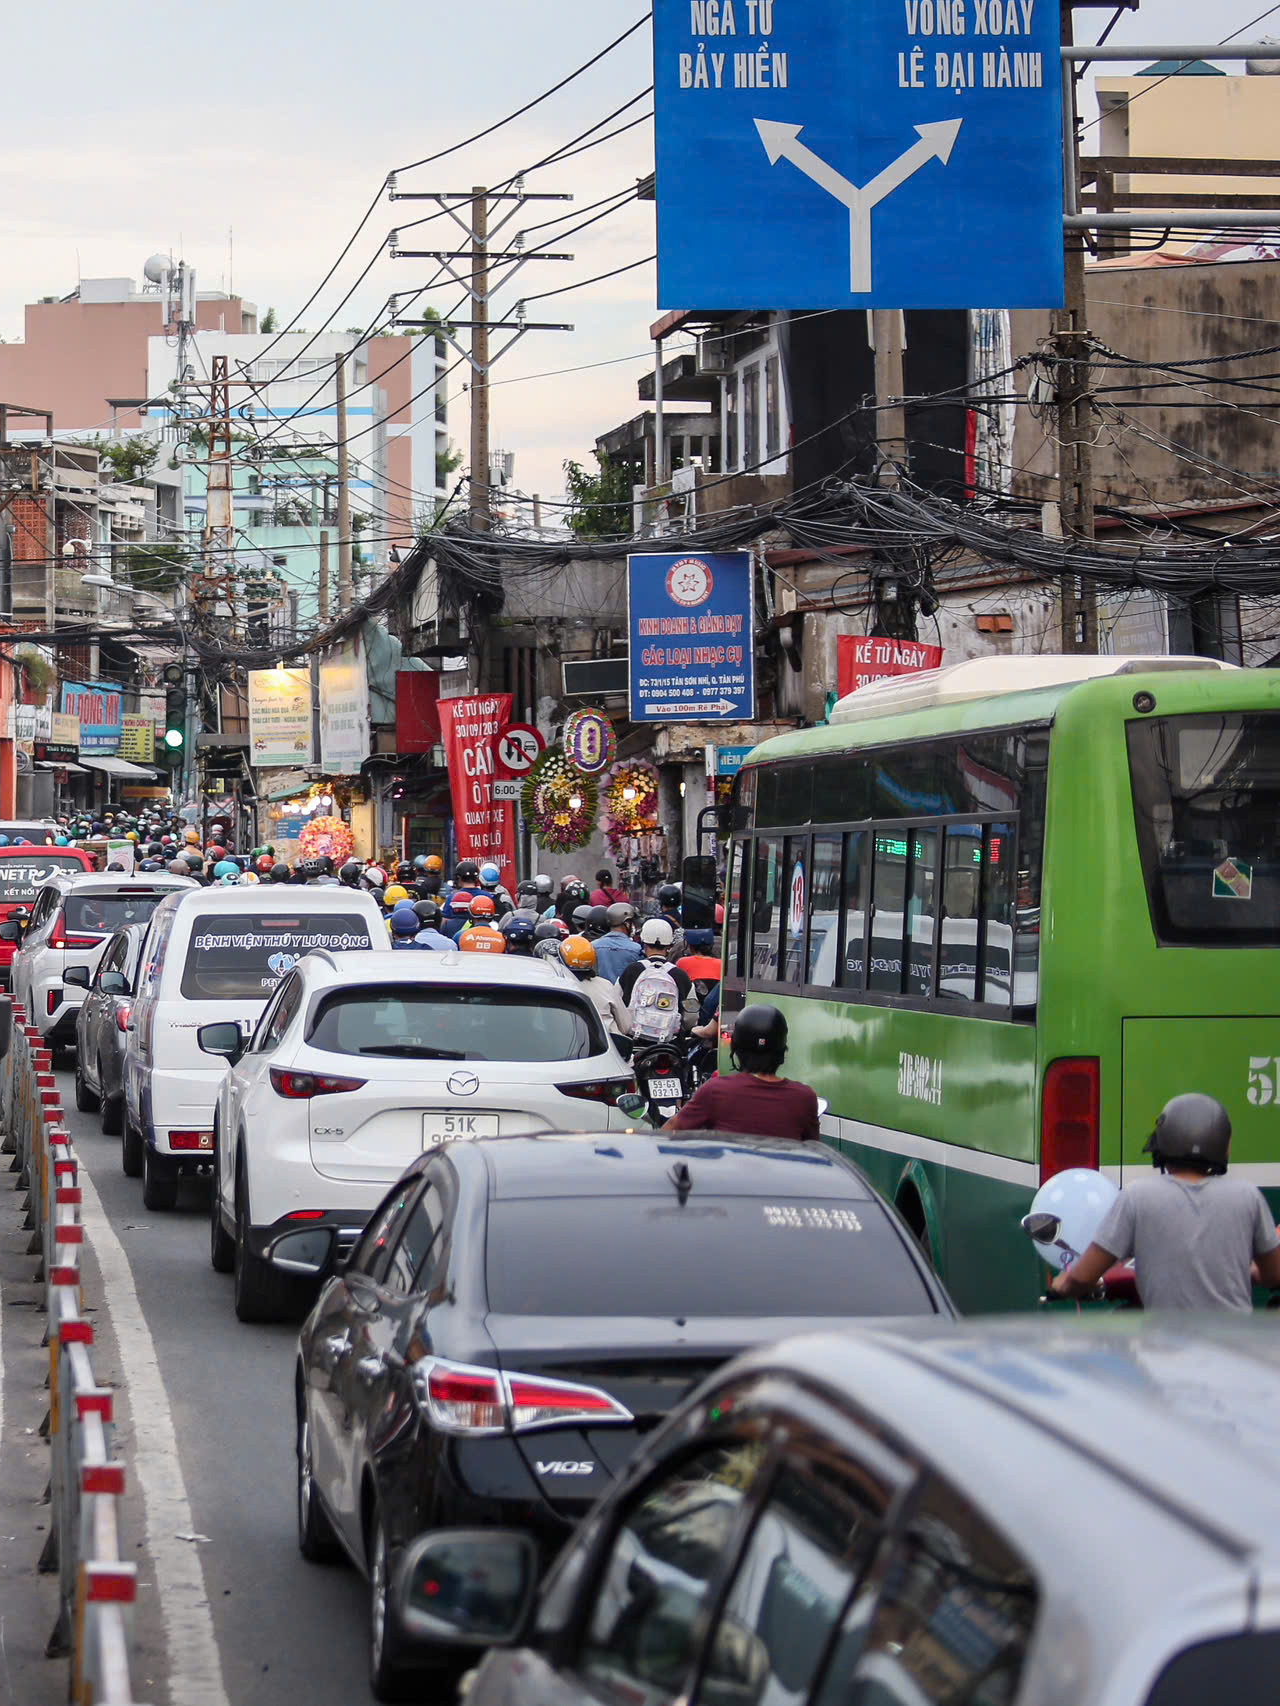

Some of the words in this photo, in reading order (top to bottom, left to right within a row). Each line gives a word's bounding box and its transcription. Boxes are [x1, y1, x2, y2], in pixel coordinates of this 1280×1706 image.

[679, 43, 726, 89] BẢY
[734, 41, 788, 89] HIỀN
[898, 45, 925, 88] LÊ
[934, 52, 975, 95] ĐẠI
[982, 45, 1043, 88] HÀNH
[639, 618, 659, 635] KINH
[661, 617, 689, 635] DOANH
[690, 617, 697, 634] &
[699, 609, 724, 633] GIẢNG
[725, 614, 743, 637] DẠY
[642, 644, 665, 666] CÁC
[666, 647, 692, 669] LOẠI
[694, 645, 724, 668] NHẠC
[727, 645, 743, 667] CỤ
[856, 640, 871, 664] KỂ
[875, 643, 891, 663] TỪ
[893, 645, 926, 668] NGÀY
[685, 675, 697, 685] SƠN
[732, 673, 745, 683] PHÚ
[669, 689, 681, 697] 500
[702, 688, 718, 696] 0977
[720, 687, 732, 695] 379
[733, 686, 746, 695] 397
[452, 700, 464, 719] KỂ
[466, 699, 477, 716] TỪ
[472, 782, 482, 804] Ô
[465, 812, 485, 826] QUAY
[493, 808, 504, 823] XE
[469, 833, 482, 850] TẠI
[4, 886, 20, 896] KẾT
[21, 886, 35, 896] NỐI
[195, 933, 233, 950] BỆNH
[233, 932, 265, 950] VIỆN
[264, 932, 292, 947] THÚ
[291, 935, 303, 947] Y
[302, 932, 330, 947] LƯU
[330, 933, 369, 950] ĐỘNG
[652, 1089, 680, 1097] 032.13
[653, 1080, 676, 1089] 59-G3
[314, 1127, 345, 1136] CX-5
[444, 1116, 477, 1133] 51K
[536, 1461, 595, 1475] VIOS
